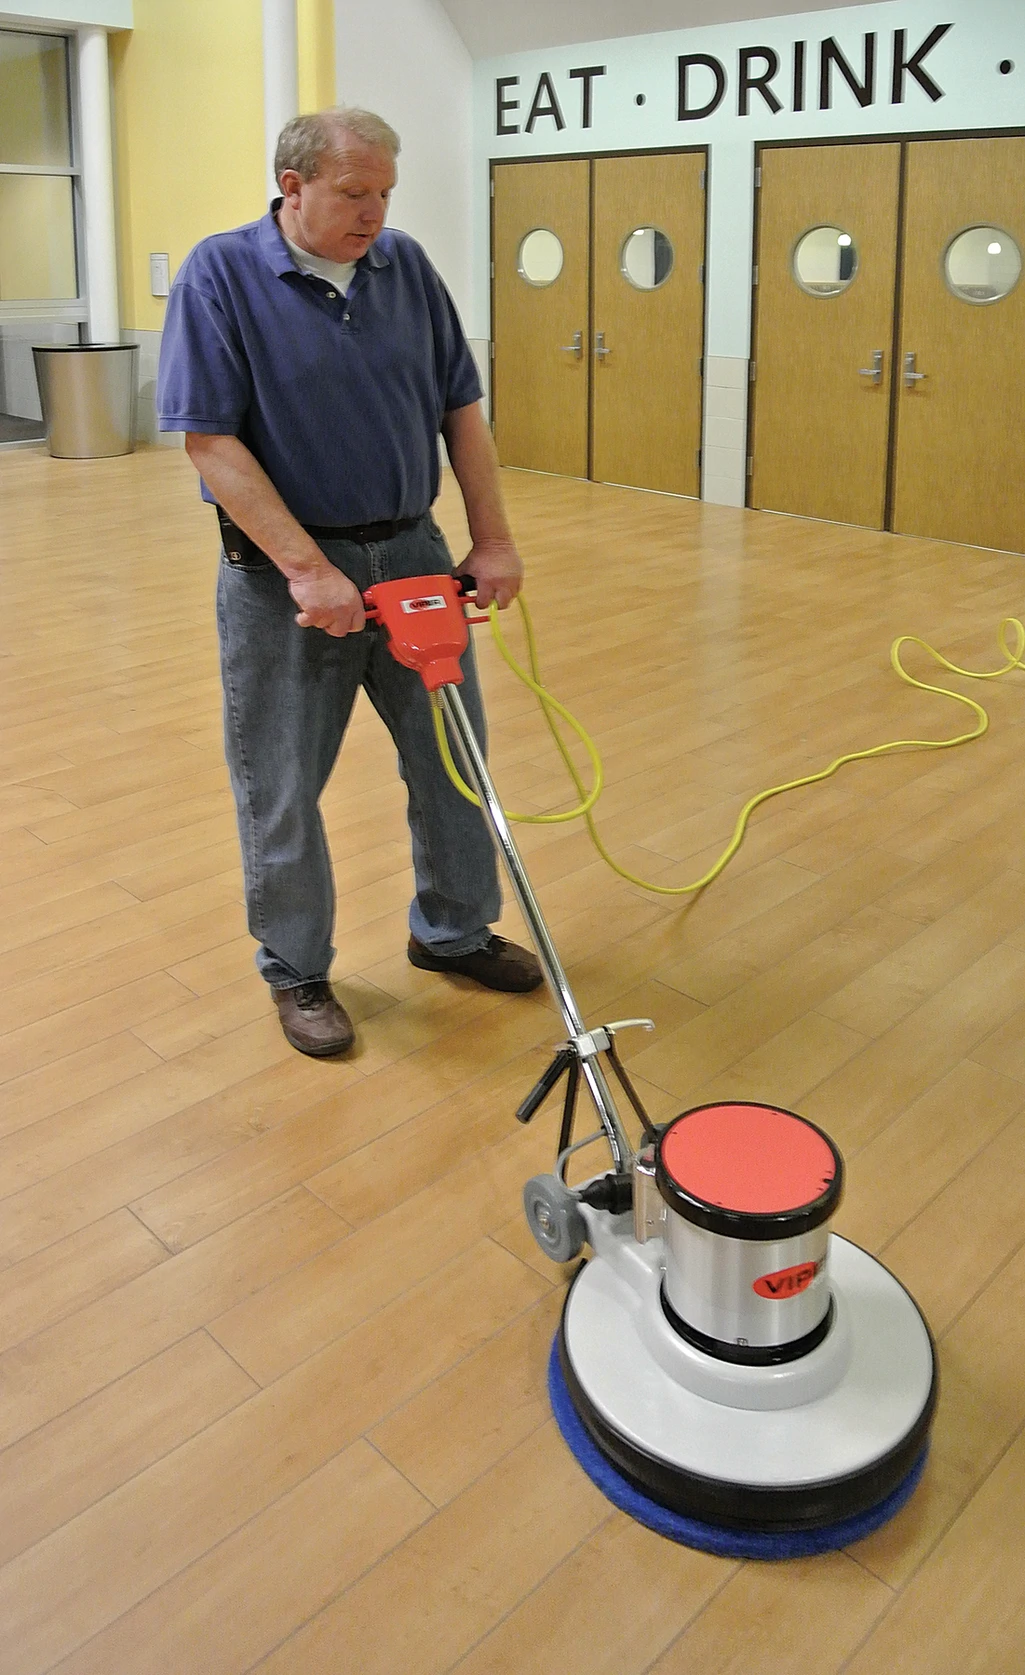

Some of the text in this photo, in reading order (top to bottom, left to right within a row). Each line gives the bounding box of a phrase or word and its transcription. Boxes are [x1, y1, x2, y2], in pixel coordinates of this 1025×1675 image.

[496, 23, 954, 135] EAT DRINK
[765, 1258, 824, 1293] VIP
